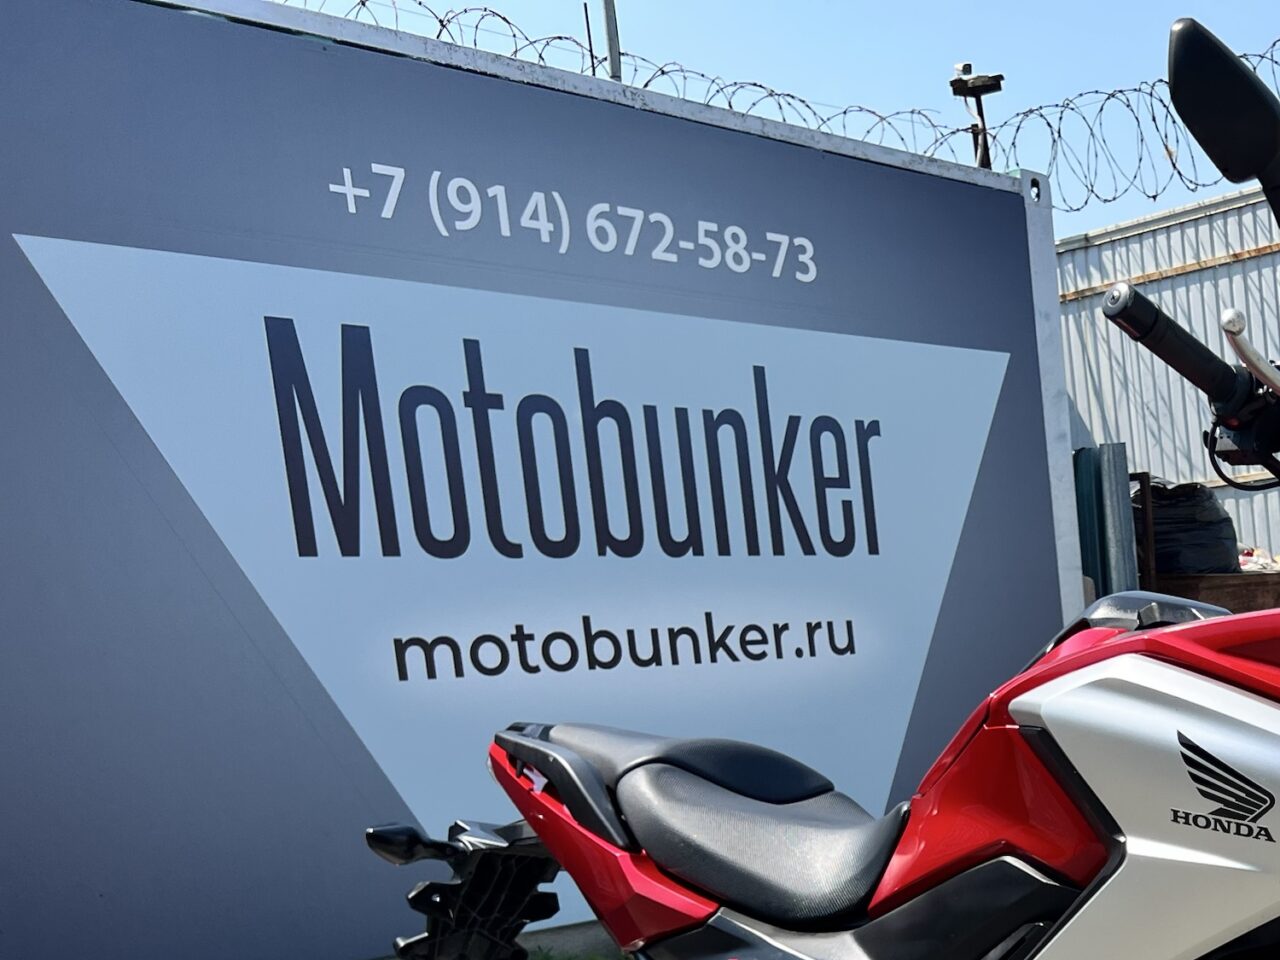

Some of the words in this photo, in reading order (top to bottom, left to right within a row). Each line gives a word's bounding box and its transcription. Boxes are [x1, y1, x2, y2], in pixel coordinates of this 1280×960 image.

[328, 162, 407, 219] +7
[428, 170, 570, 254] (914)
[585, 202, 818, 284] 672-58-73
[264, 315, 881, 560] Motobunker
[393, 612, 857, 682] motobunker.ru
[1170, 808, 1277, 843] HONDA
